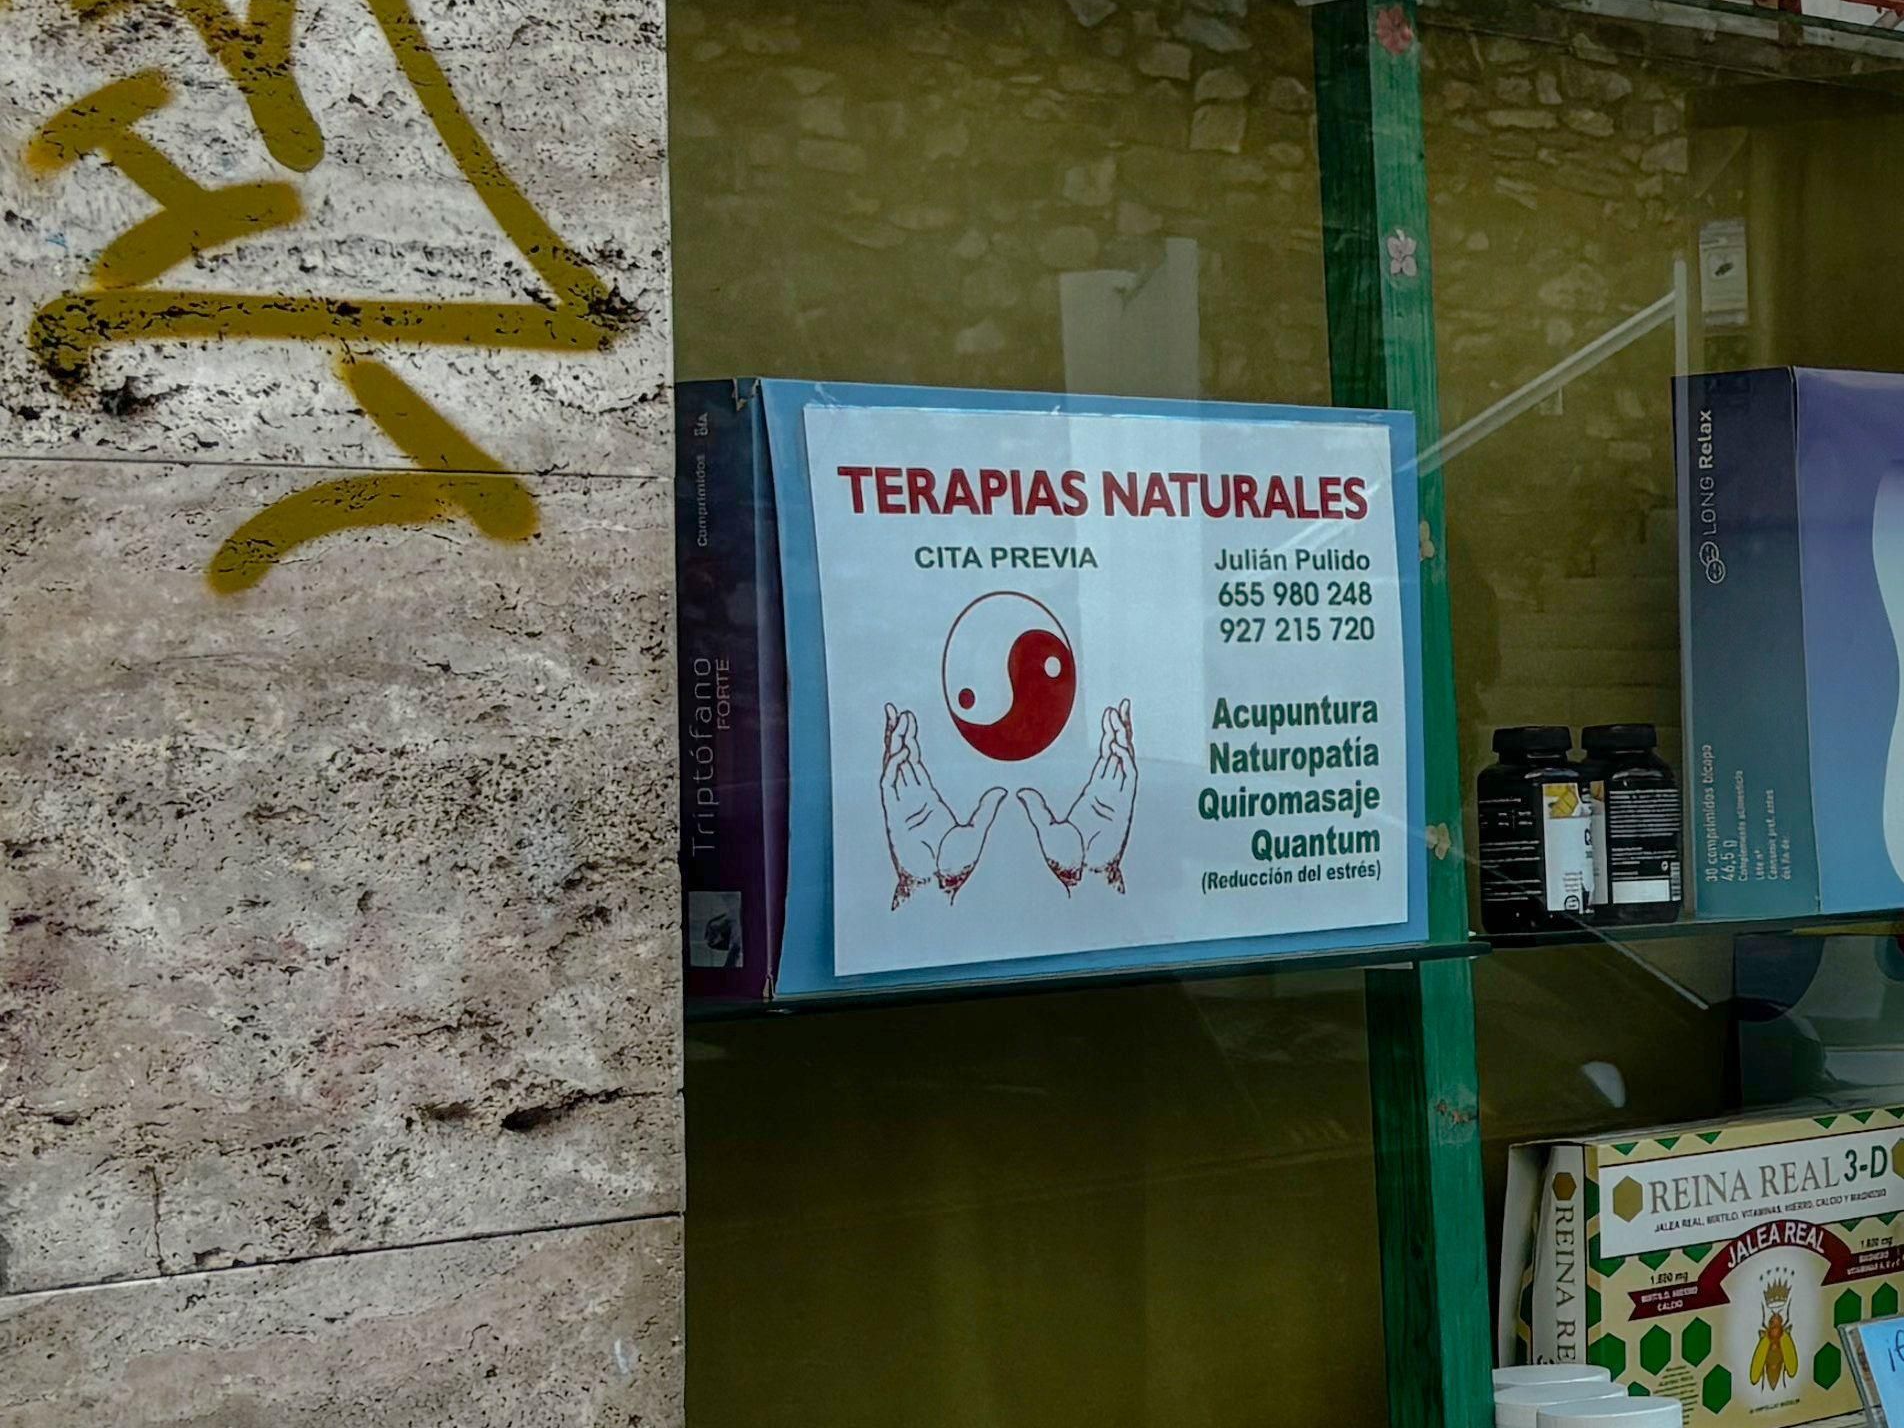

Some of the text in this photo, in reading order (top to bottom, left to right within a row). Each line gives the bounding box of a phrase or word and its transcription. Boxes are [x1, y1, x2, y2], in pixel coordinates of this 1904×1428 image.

[837, 465, 1369, 520] TERAPIAS NATURALES
[1698, 409, 1717, 538] LONG Relax
[914, 546, 1099, 569] CITA PREVIA
[1214, 547, 1371, 572] Julián Pulido
[1218, 580, 1373, 608] 655 980 248
[1219, 616, 1376, 644] 927 215 720
[716, 658, 731, 731] FORTE
[1211, 694, 1379, 735] Acupuntura
[691, 656, 721, 858] Triptófano
[1209, 735, 1380, 778] Naturopatía
[1198, 779, 1381, 822] Quiromasaje
[1251, 825, 1381, 862] Quantum
[1703, 785, 1719, 865] comprimidos
[1201, 859, 1382, 895] (Reducción del estrés)
[1705, 868, 1718, 882] 30
[1649, 1144, 1889, 1215] REINA REAL 3-D
[1554, 1206, 1576, 1309] REINA
[1727, 1224, 1778, 1269] JALEA
[1784, 1223, 1826, 1254] REAL
